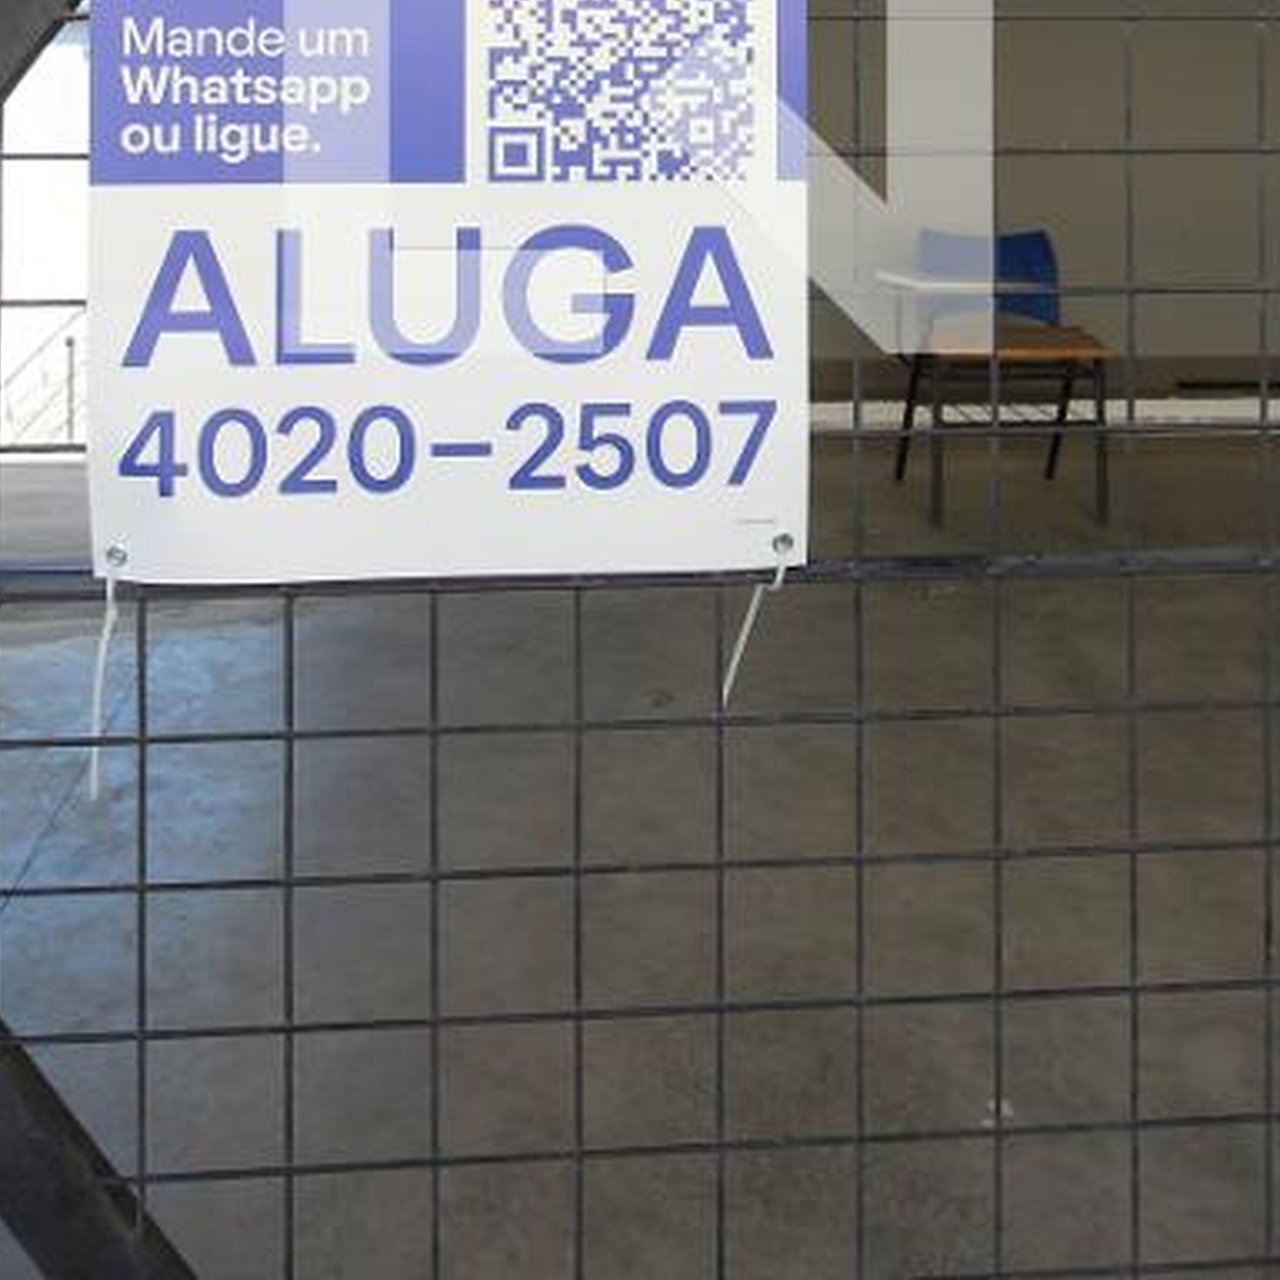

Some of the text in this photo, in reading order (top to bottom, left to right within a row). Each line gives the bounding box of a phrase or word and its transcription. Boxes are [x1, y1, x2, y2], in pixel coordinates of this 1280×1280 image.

[121, 17, 370, 58] Mande um
[121, 65, 371, 112] Whatsapp
[120, 114, 321, 162] ou ligue.
[120, 223, 775, 368] ALUGA
[119, 400, 778, 499] 4020-2507
